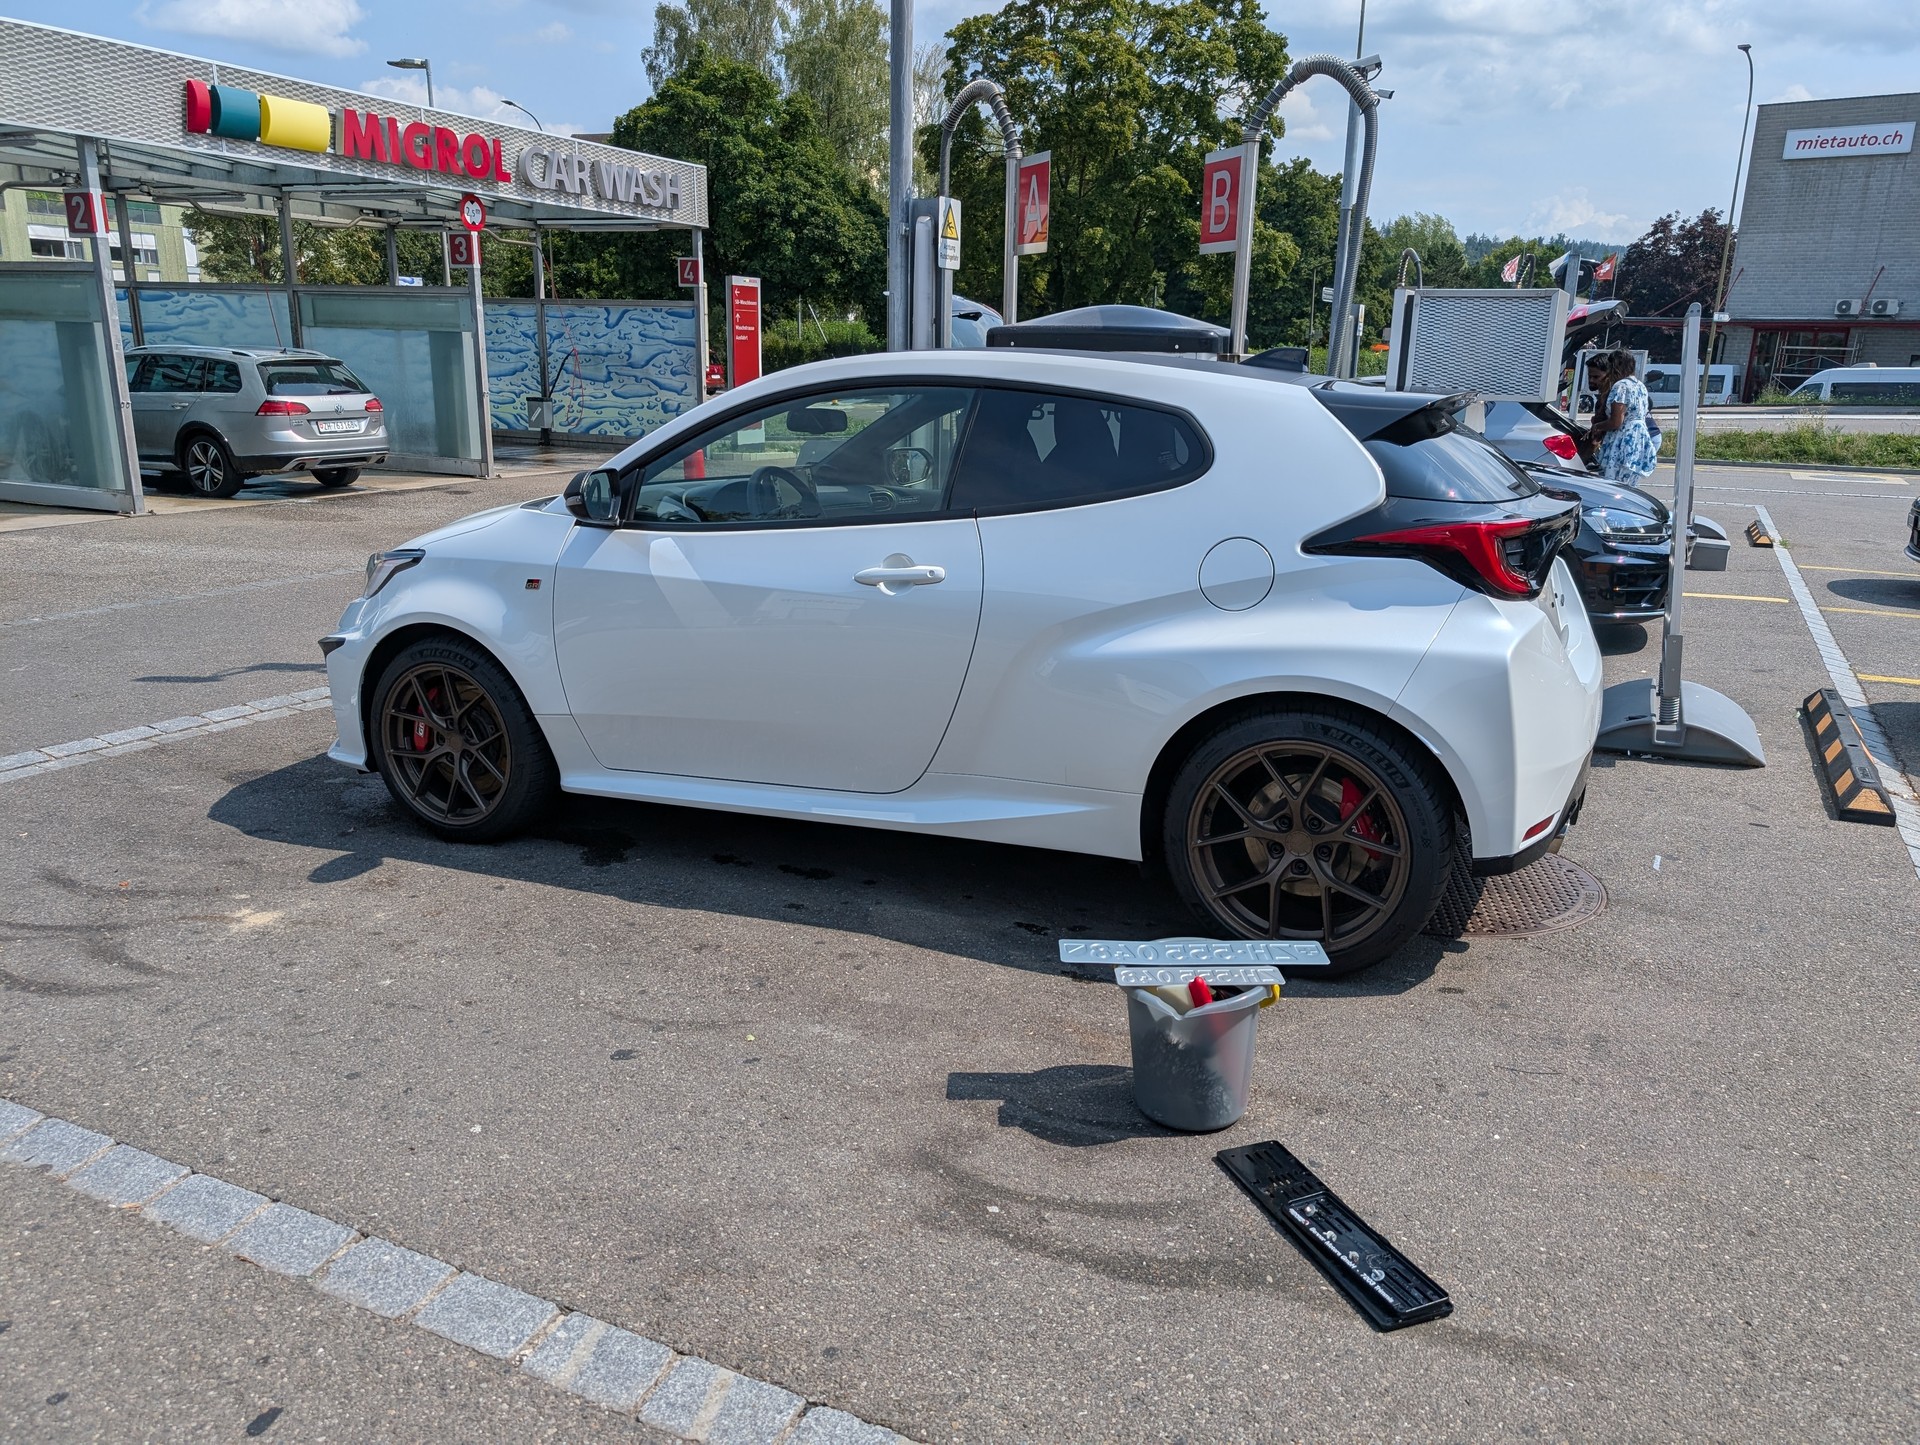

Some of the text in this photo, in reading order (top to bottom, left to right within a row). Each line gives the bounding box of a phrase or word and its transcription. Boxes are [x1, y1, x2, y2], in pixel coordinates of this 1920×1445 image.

[1795, 130, 1903, 150] mietauto.ch
[339, 108, 682, 209] MIGROL CAR WASH
[71, 195, 89, 229] 2
[1023, 174, 1042, 235] A
[1209, 170, 1232, 234] B
[454, 236, 467, 262] 3
[684, 262, 694, 281] 4
[423, 648, 474, 669] MICHELIN
[1329, 728, 1408, 788] MICHELIN
